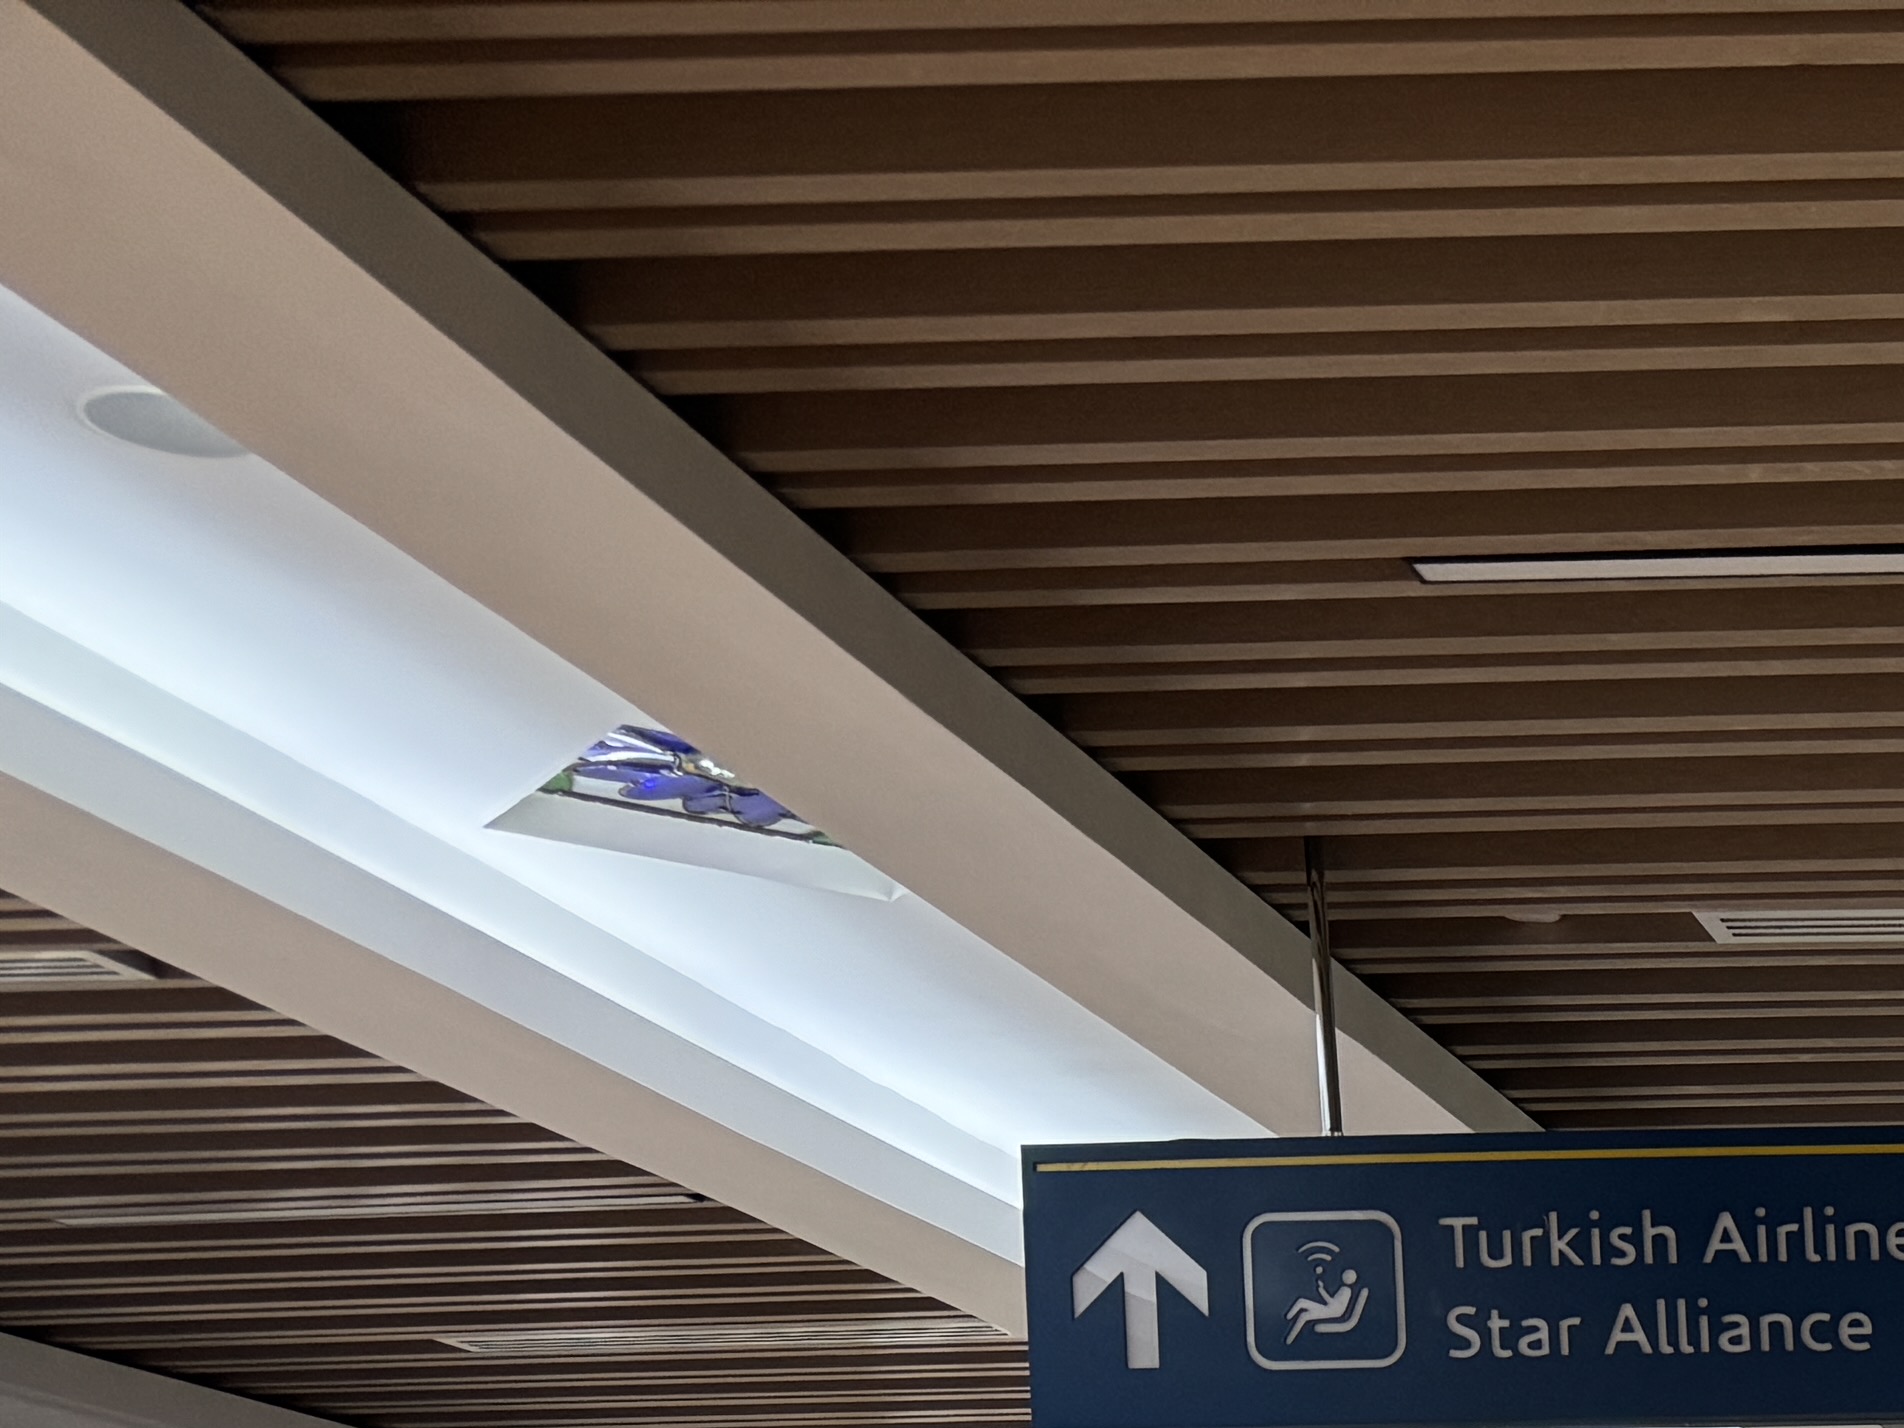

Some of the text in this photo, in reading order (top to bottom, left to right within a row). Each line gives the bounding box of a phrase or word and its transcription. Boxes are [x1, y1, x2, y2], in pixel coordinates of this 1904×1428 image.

[1439, 1208, 1679, 1271] Turkish
[1446, 1296, 1875, 1360] Star Alliance
